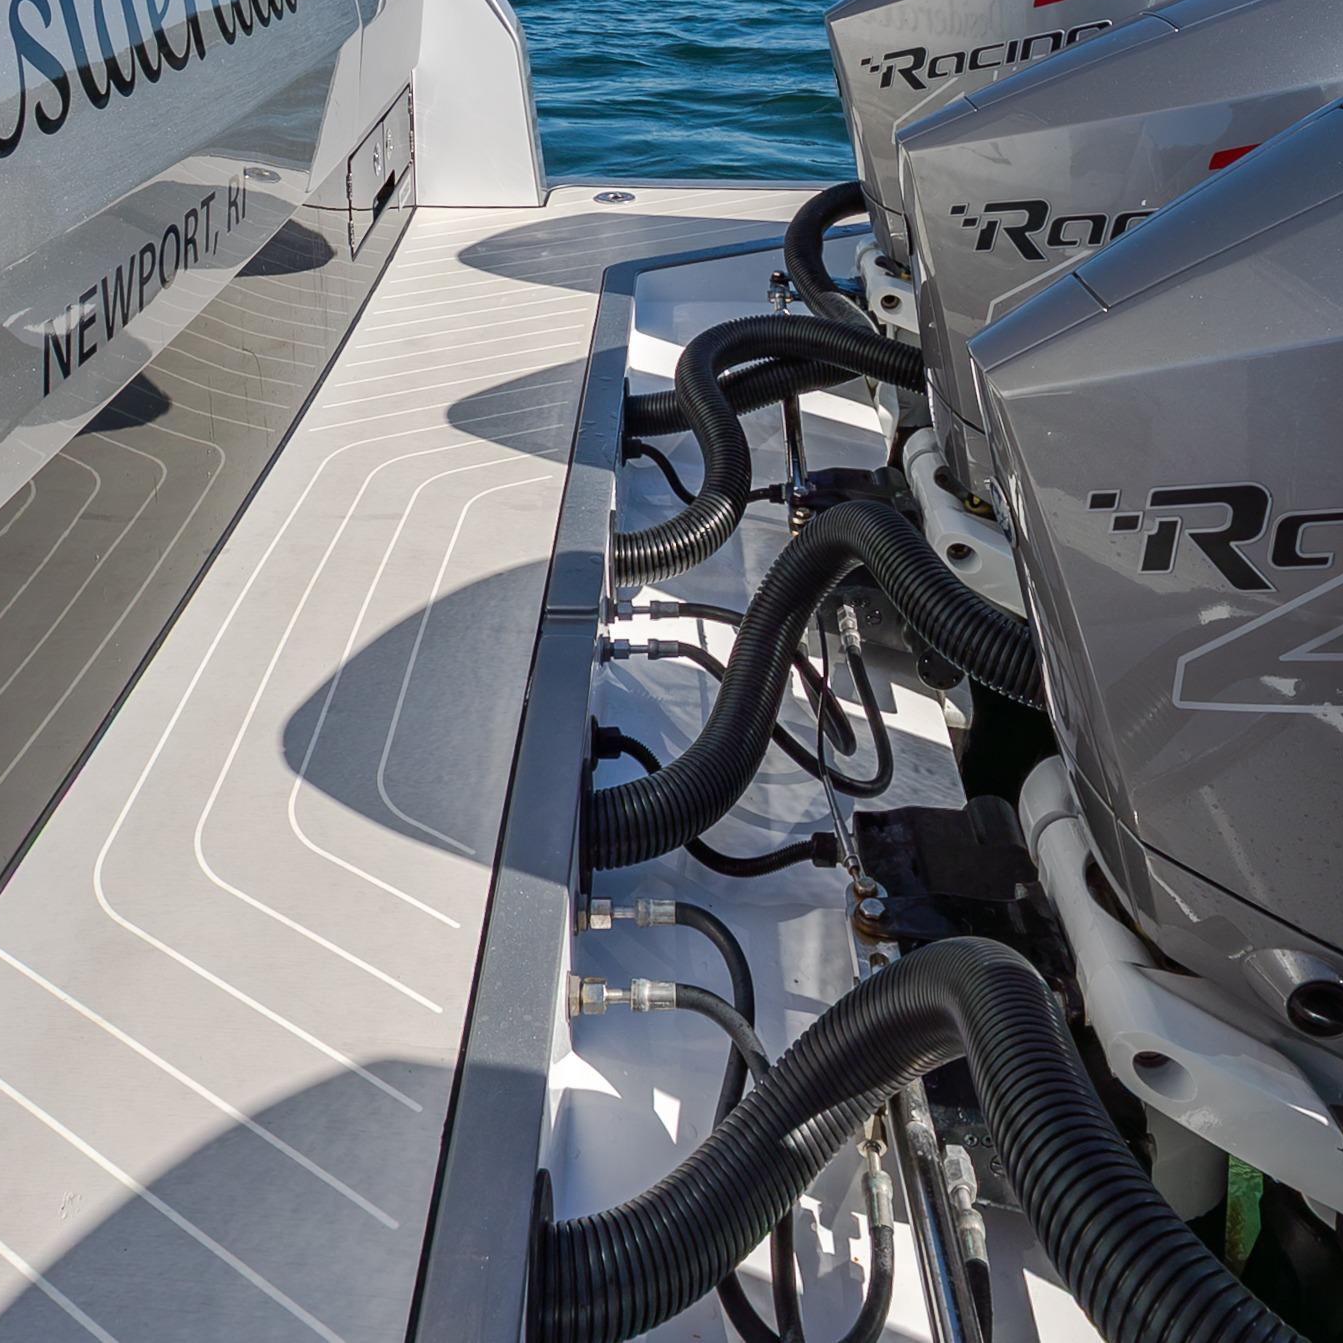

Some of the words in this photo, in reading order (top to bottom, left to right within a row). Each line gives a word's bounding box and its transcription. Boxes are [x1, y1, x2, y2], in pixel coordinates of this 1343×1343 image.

[43, 191, 219, 397] NEWPORT,
[226, 166, 247, 233] RI
[972, 199, 1160, 262] Rac
